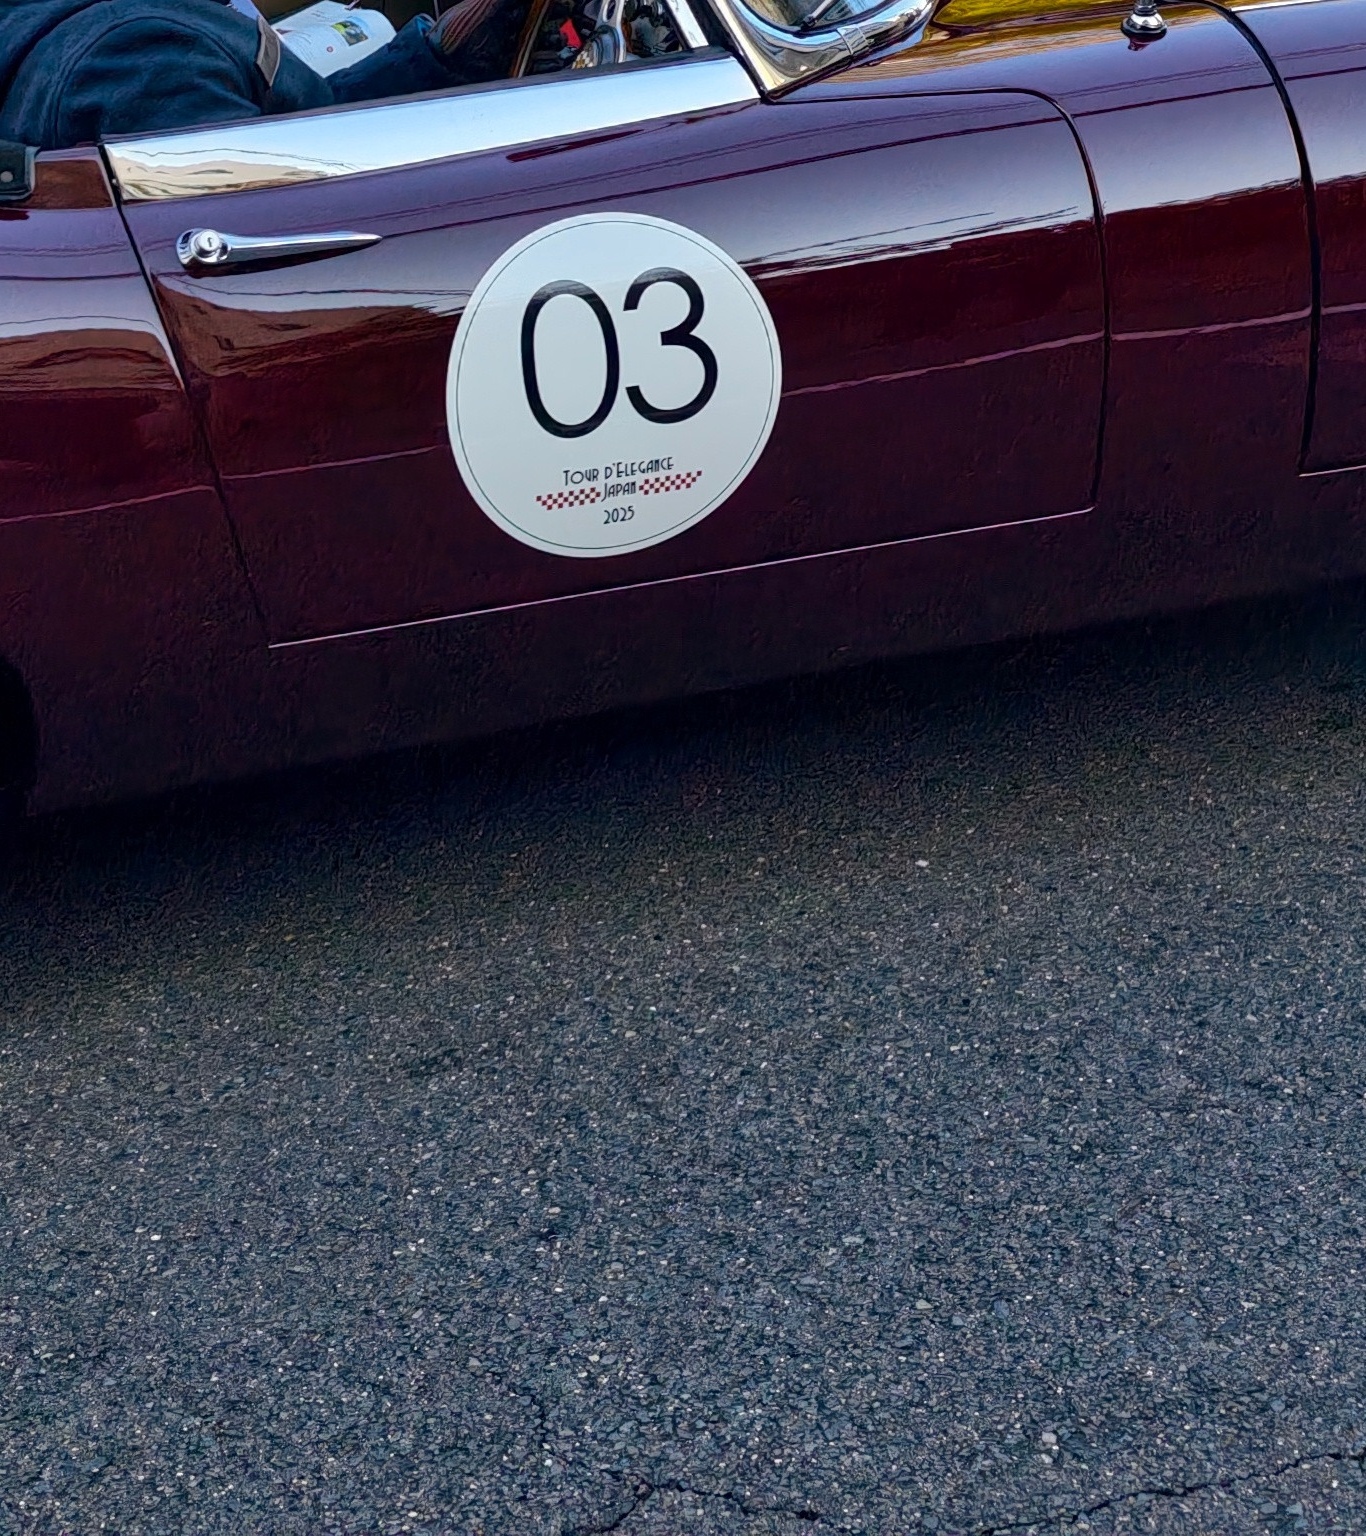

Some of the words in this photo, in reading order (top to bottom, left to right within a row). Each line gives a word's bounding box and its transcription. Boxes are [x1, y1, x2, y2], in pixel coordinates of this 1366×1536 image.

[520, 266, 718, 439] 03
[563, 468, 600, 486] TOUR
[604, 456, 674, 480] D'ELEGANCE
[601, 481, 637, 502] JAPAN
[603, 505, 635, 524] 2025
